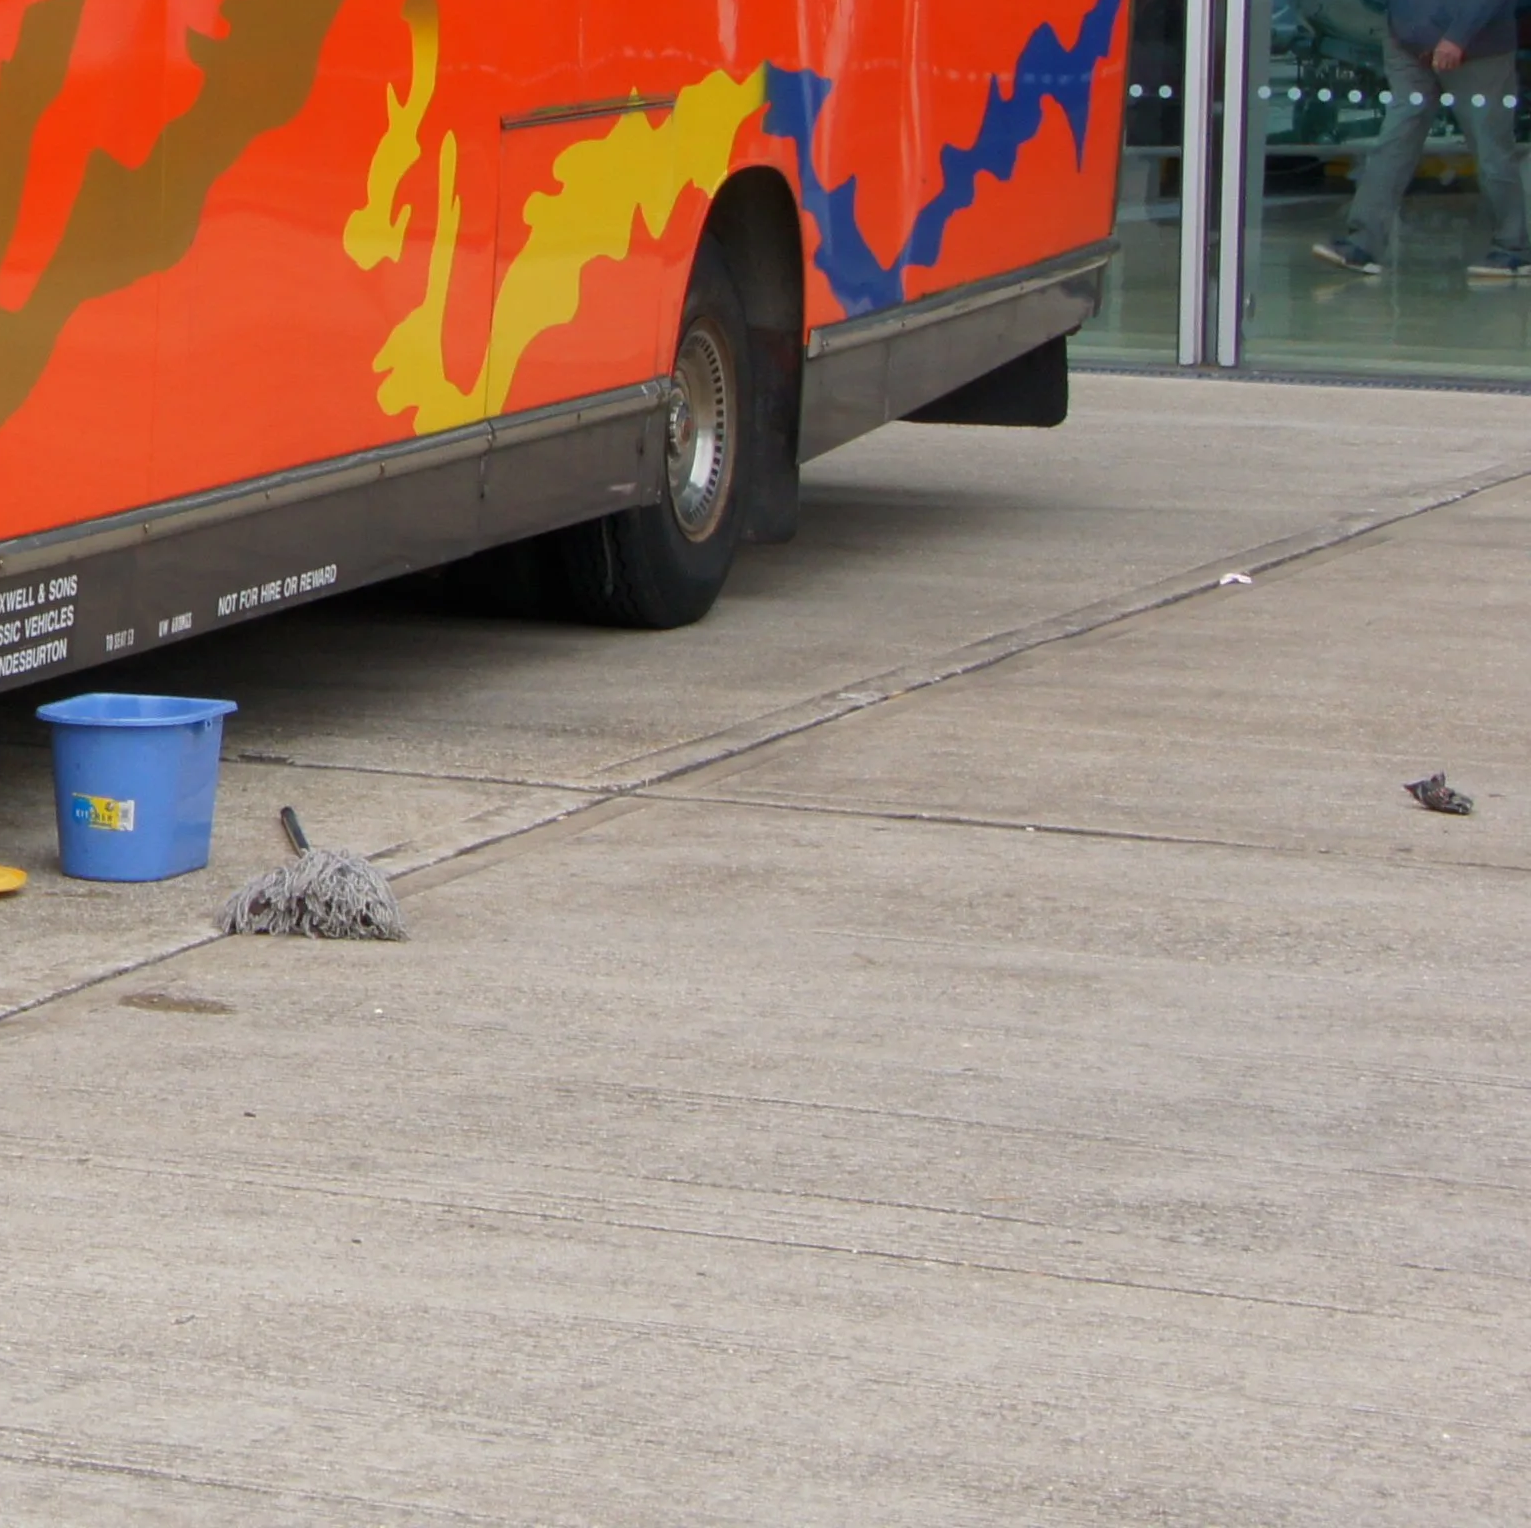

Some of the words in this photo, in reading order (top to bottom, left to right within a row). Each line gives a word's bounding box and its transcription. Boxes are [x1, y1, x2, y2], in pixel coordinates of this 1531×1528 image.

[37, 583, 46, 604] &
[48, 574, 79, 602] SONS
[217, 593, 238, 617] NOT
[239, 587, 259, 610] FOR
[260, 579, 283, 604] HIRE
[283, 575, 299, 598] OR
[299, 563, 338, 592] REWARD
[24, 604, 75, 639] VEHICLES
